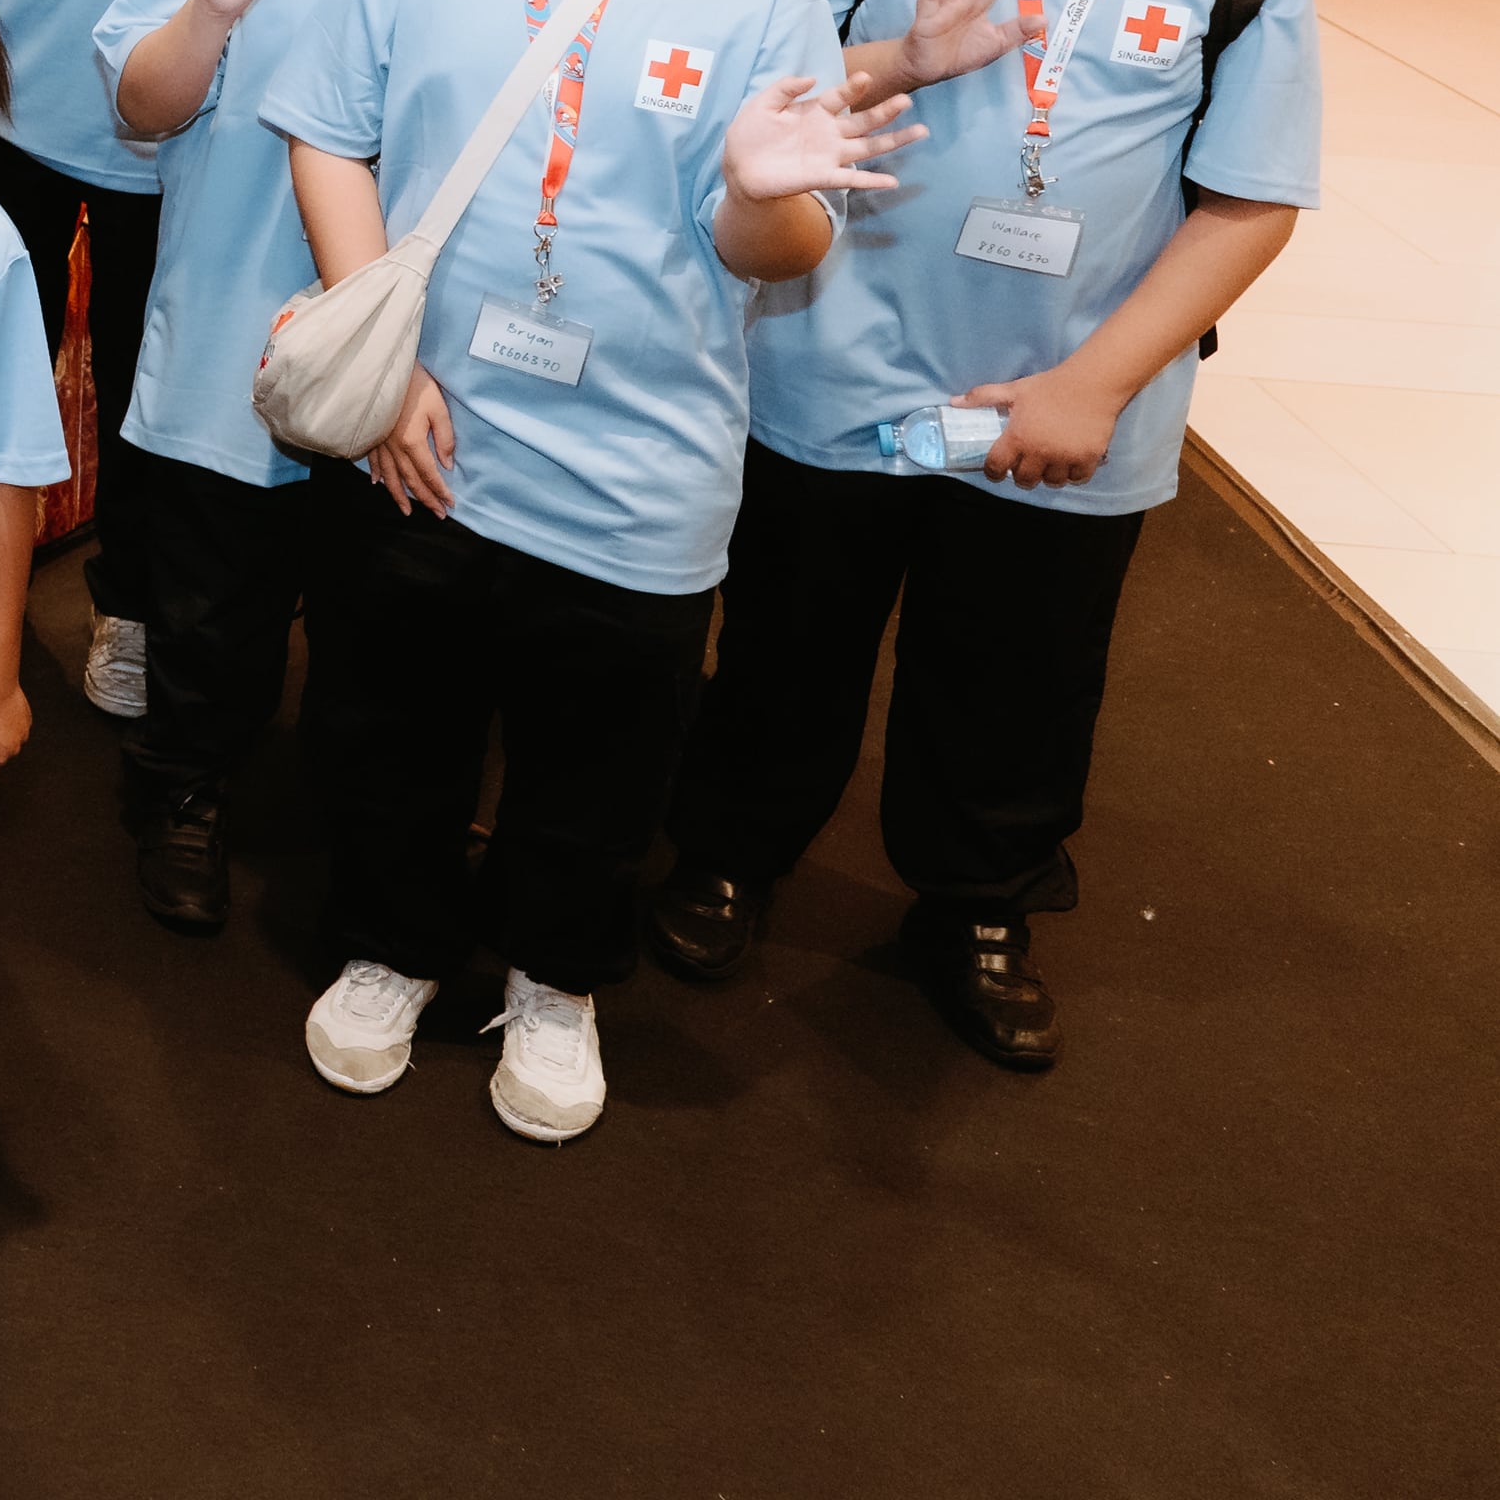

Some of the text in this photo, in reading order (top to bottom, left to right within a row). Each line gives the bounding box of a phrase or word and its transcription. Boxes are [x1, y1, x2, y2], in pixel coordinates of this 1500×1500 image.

[1117, 50, 1173, 67] SINGAPORE
[641, 95, 694, 114] SINGAPORE
[506, 322, 554, 349] Bryan
[492, 340, 561, 373] 88606370
